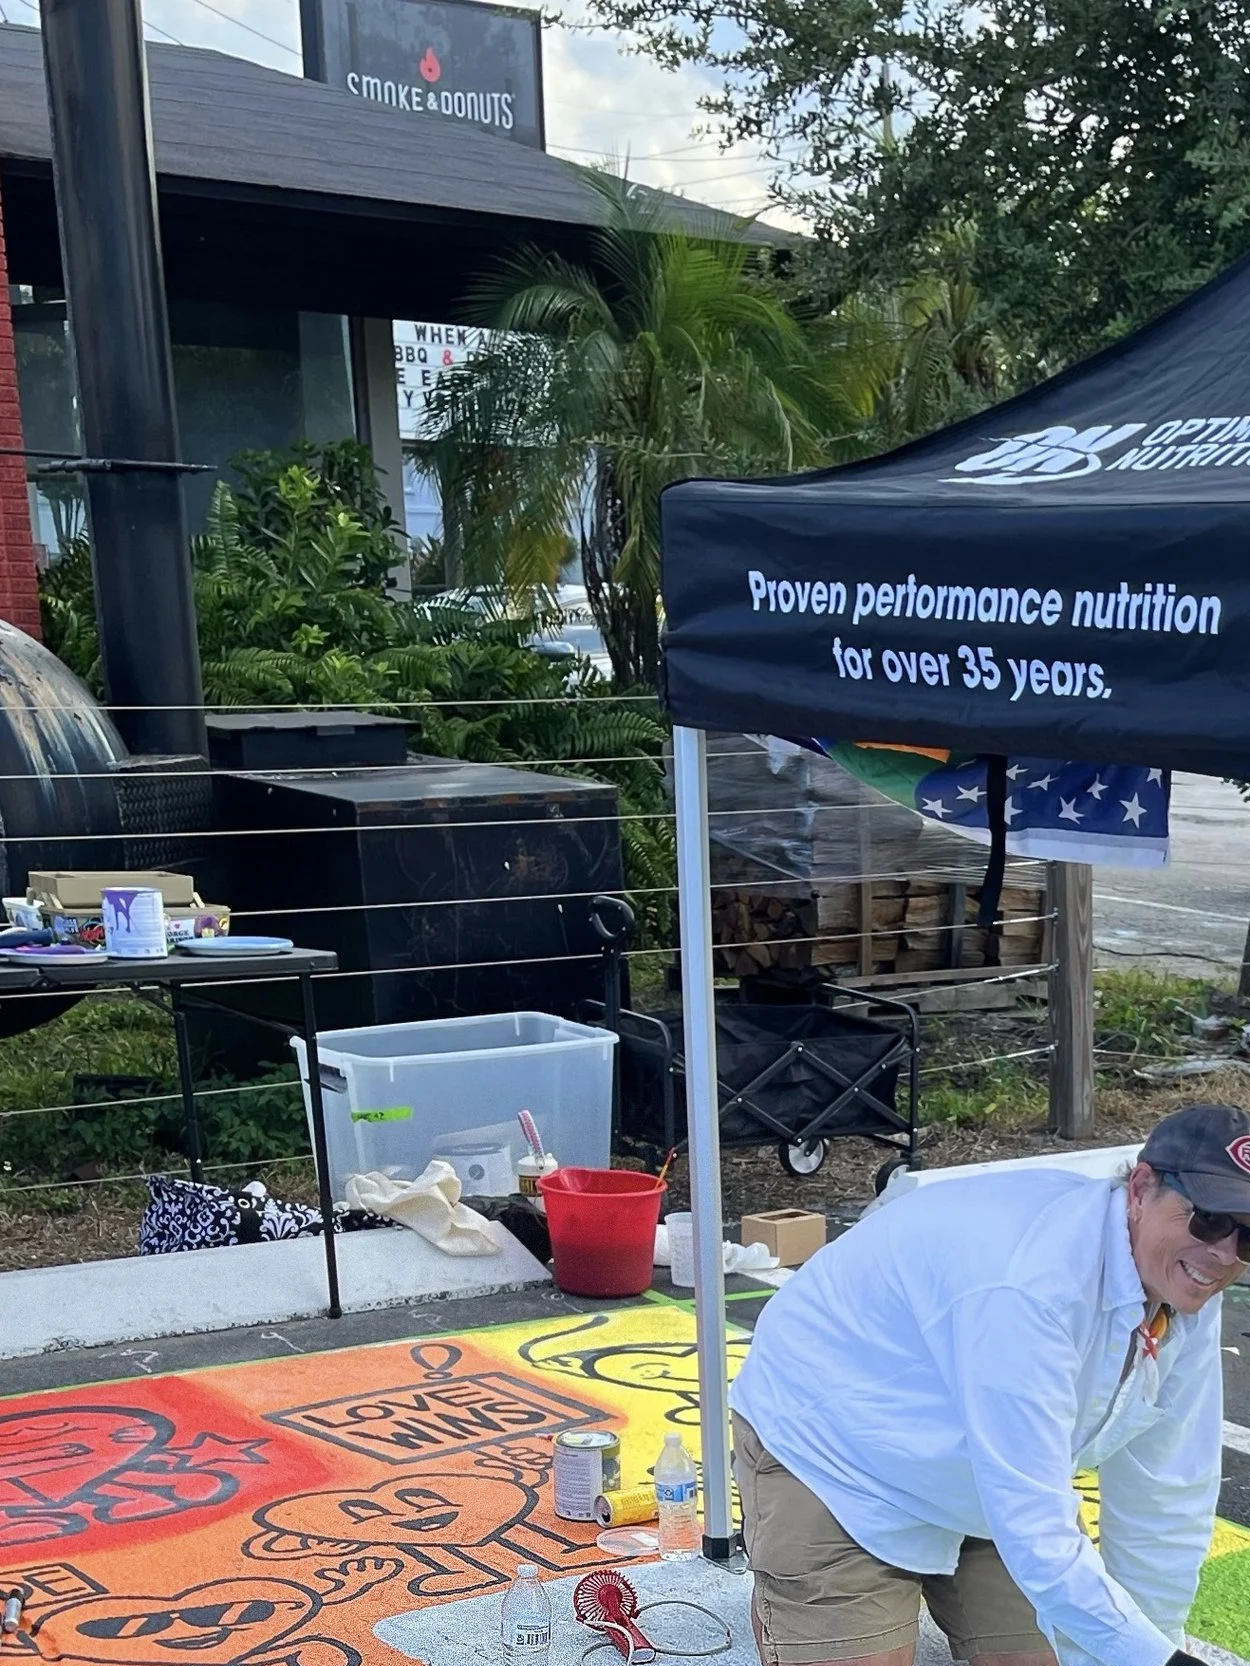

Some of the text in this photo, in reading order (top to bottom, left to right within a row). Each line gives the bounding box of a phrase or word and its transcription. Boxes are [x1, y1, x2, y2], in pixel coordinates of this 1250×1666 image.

[347, 72, 514, 130] SMOKE & DONUTS
[395, 345, 428, 364] BBQ
[414, 324, 467, 345] WHEN
[747, 569, 1222, 634] Proven performance nutrition
[831, 637, 1113, 701] for over 35 years.
[301, 1385, 483, 1429] LOVE
[345, 1397, 547, 1450] WINS
